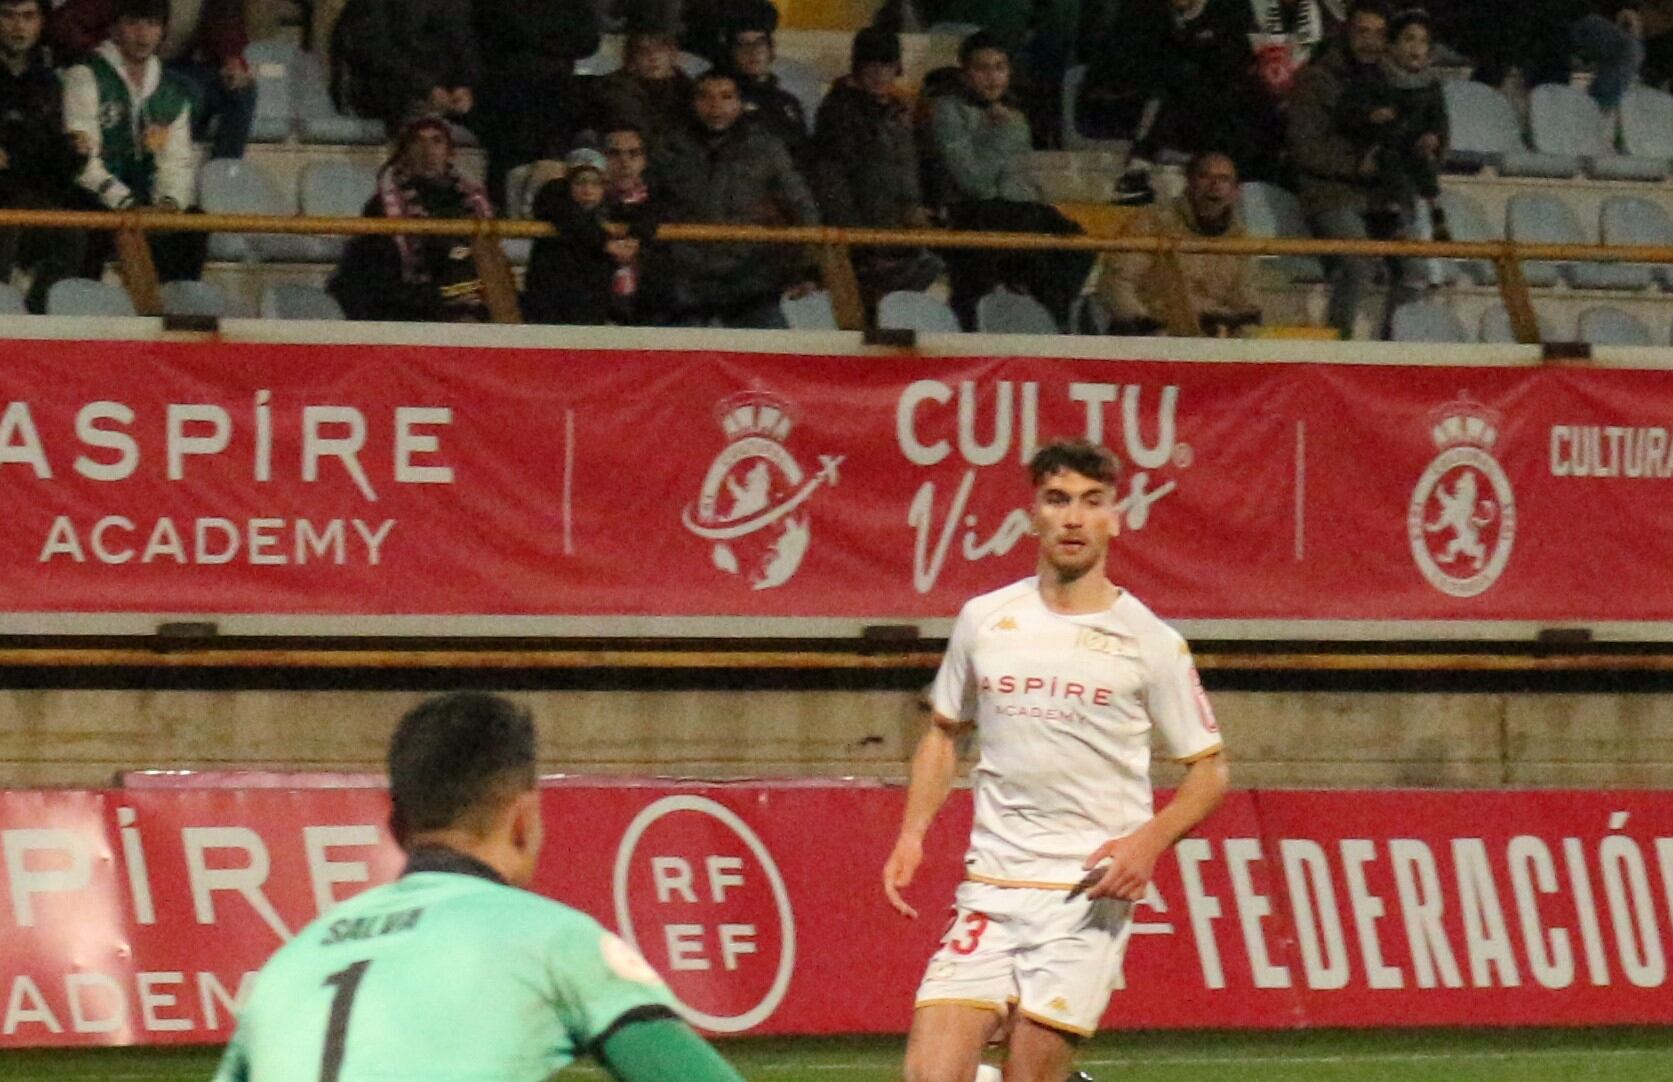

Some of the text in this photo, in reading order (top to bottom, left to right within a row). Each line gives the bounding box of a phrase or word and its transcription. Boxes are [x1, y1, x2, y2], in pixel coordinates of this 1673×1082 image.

[39, 514, 397, 566] ACADEMY
[651, 855, 745, 903] RF
[665, 923, 760, 971] EF
